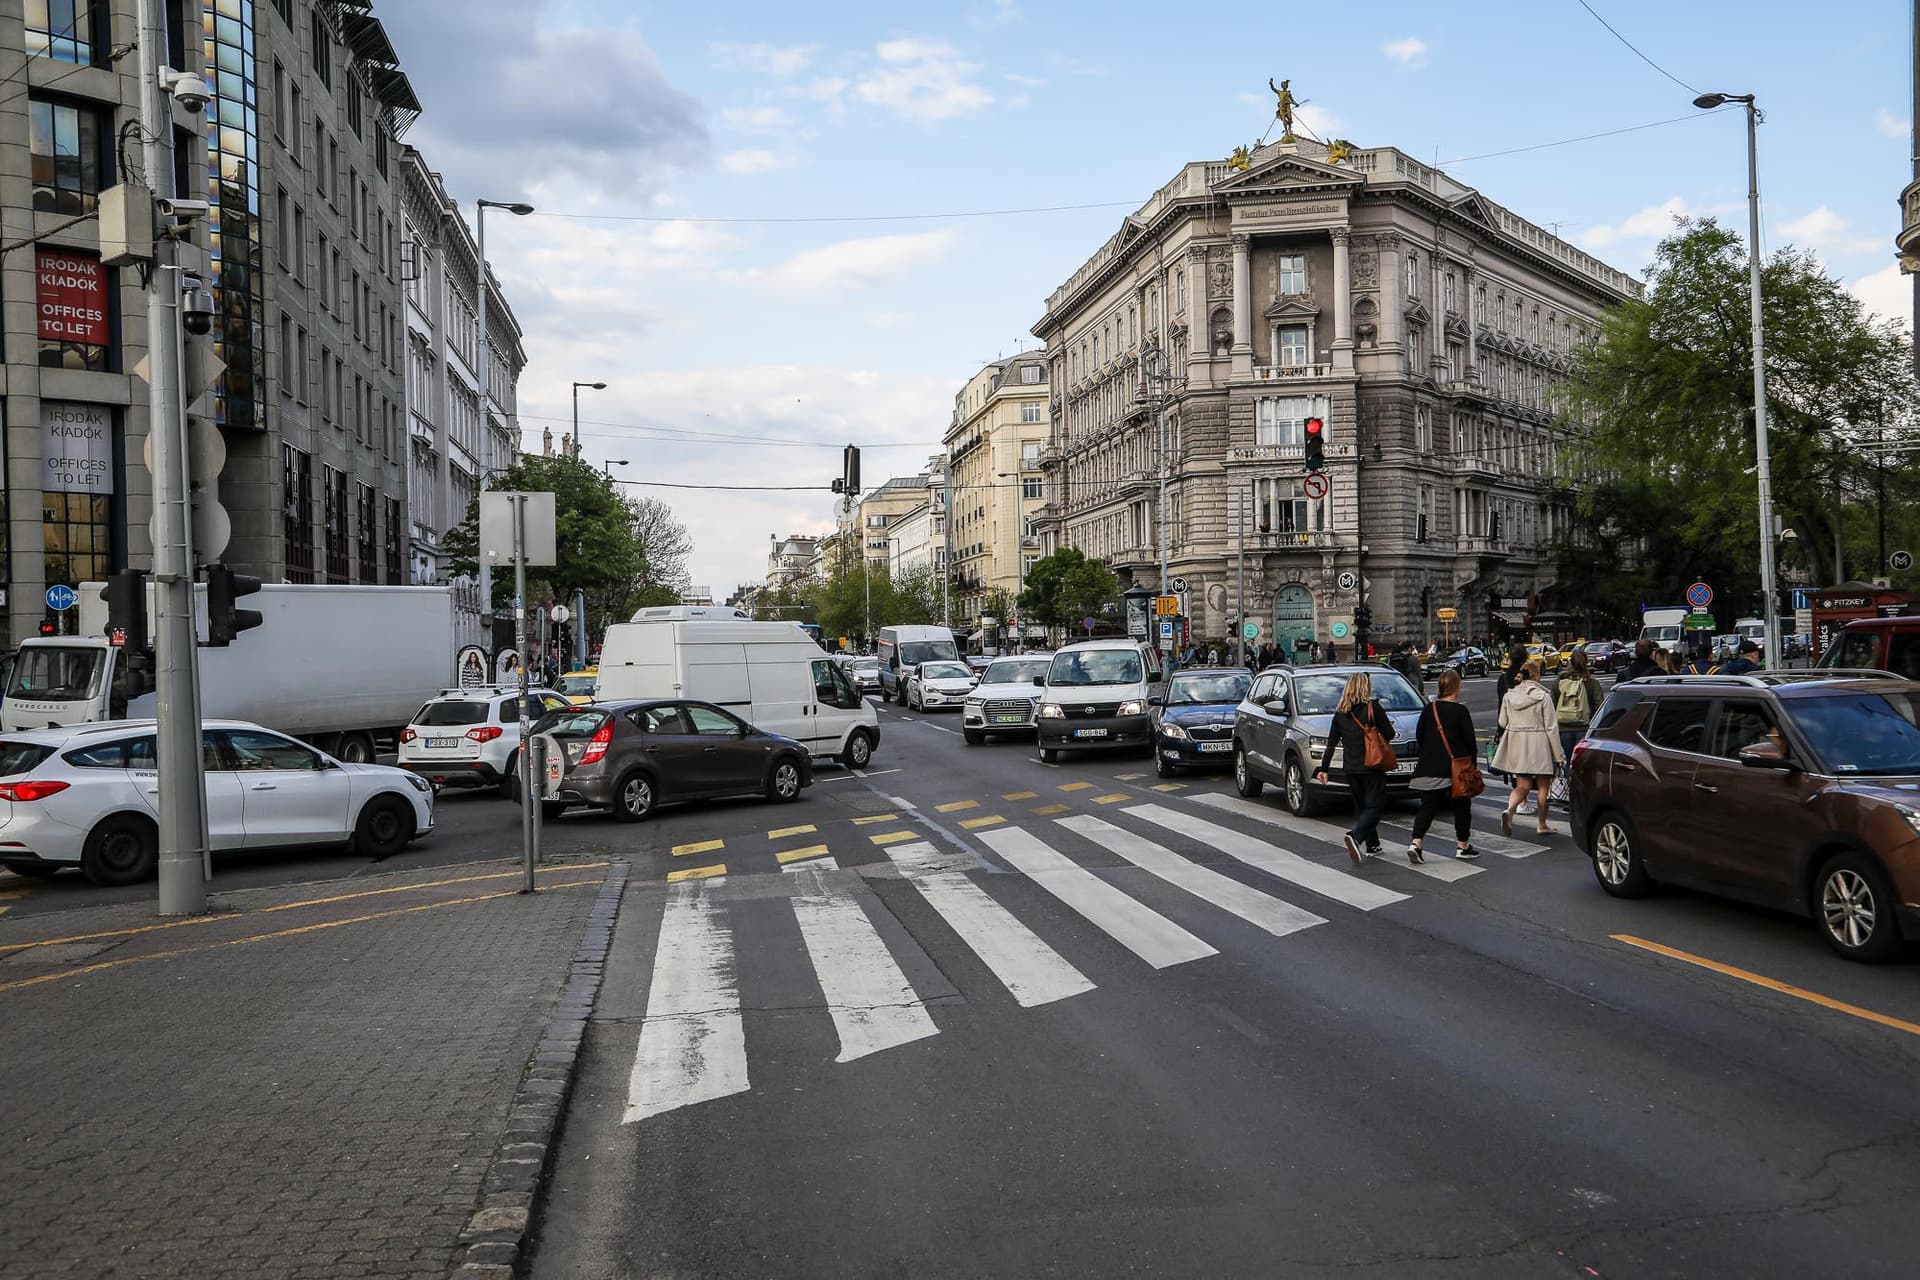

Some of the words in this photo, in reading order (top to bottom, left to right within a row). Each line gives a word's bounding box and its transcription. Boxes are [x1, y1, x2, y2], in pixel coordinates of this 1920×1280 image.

[40, 257, 97, 276] IRODÁK
[41, 273, 98, 292] KIADÓK
[42, 303, 103, 321] OFFICES
[43, 319, 63, 332] TO
[67, 322, 94, 336] LET
[50, 410, 103, 425] IRODÁK
[51, 424, 103, 440] KIADÓK
[48, 457, 107, 471] OFFICES
[55, 471, 74, 484] TO
[77, 473, 102, 486] LET
[1834, 598, 1865, 607] FITZKEY
